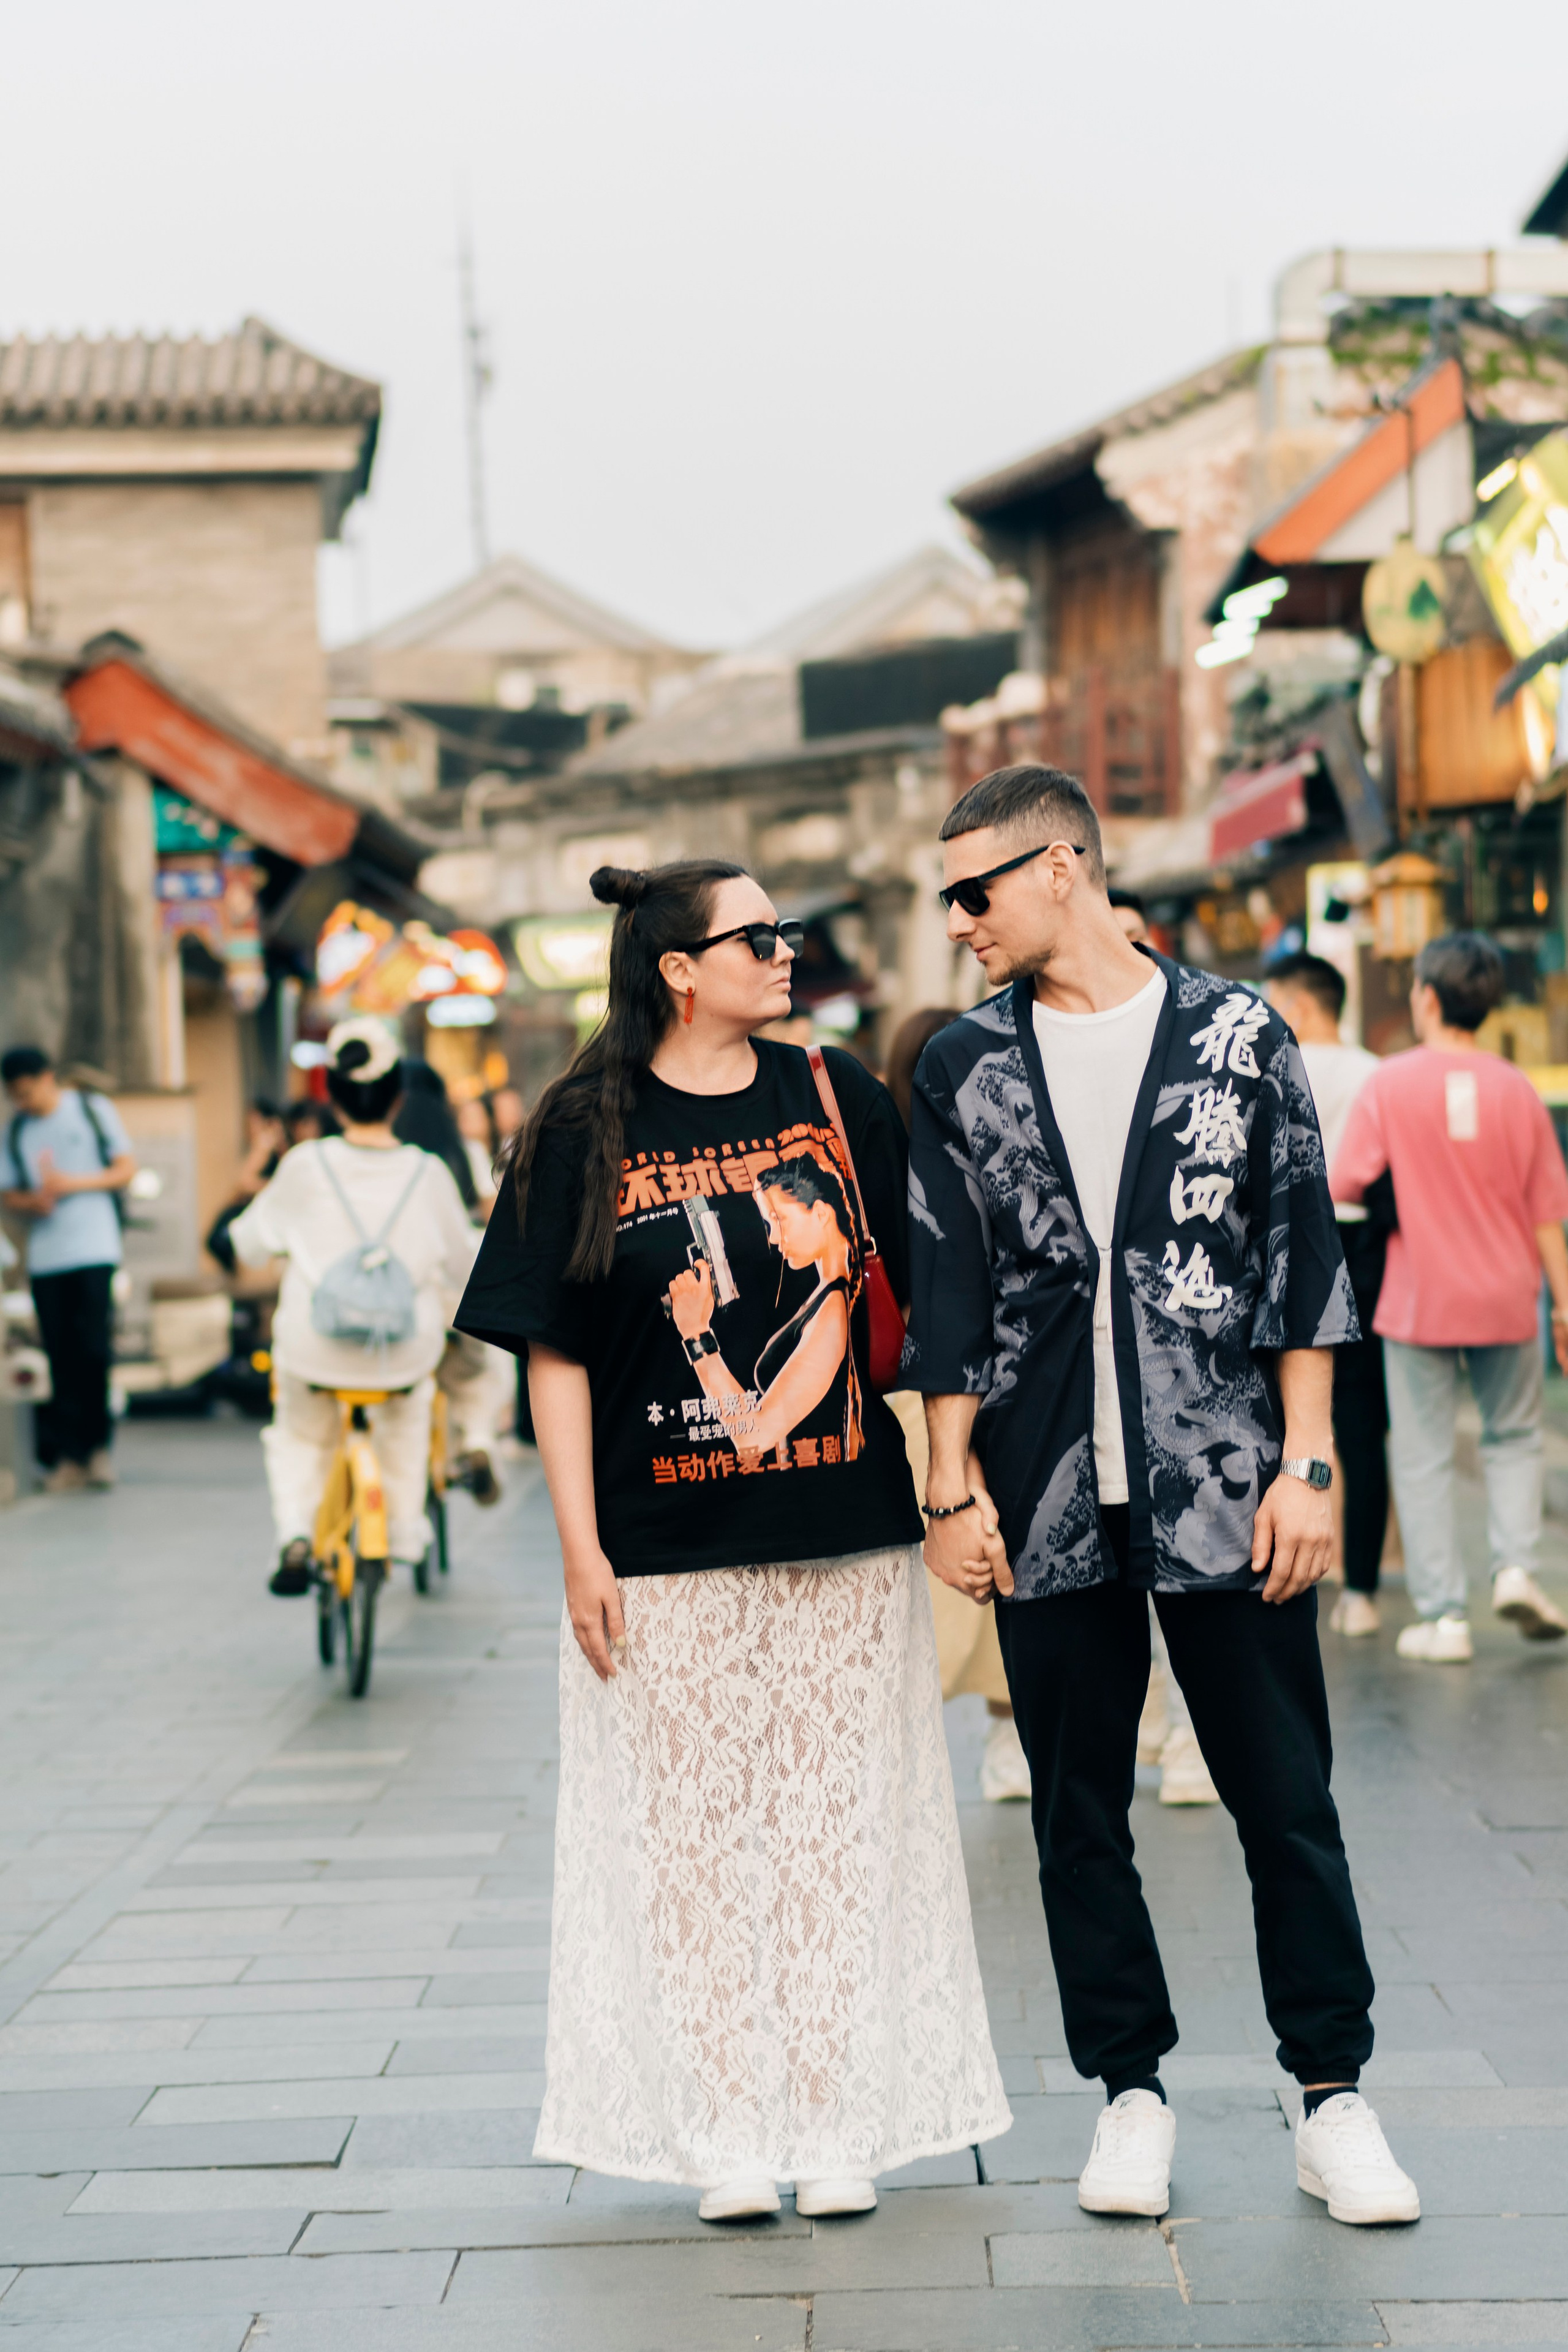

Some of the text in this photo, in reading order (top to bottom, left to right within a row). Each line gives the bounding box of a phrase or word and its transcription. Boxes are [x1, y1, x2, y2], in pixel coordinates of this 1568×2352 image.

[652, 1434, 842, 1484] 当动作爱上喜剧
